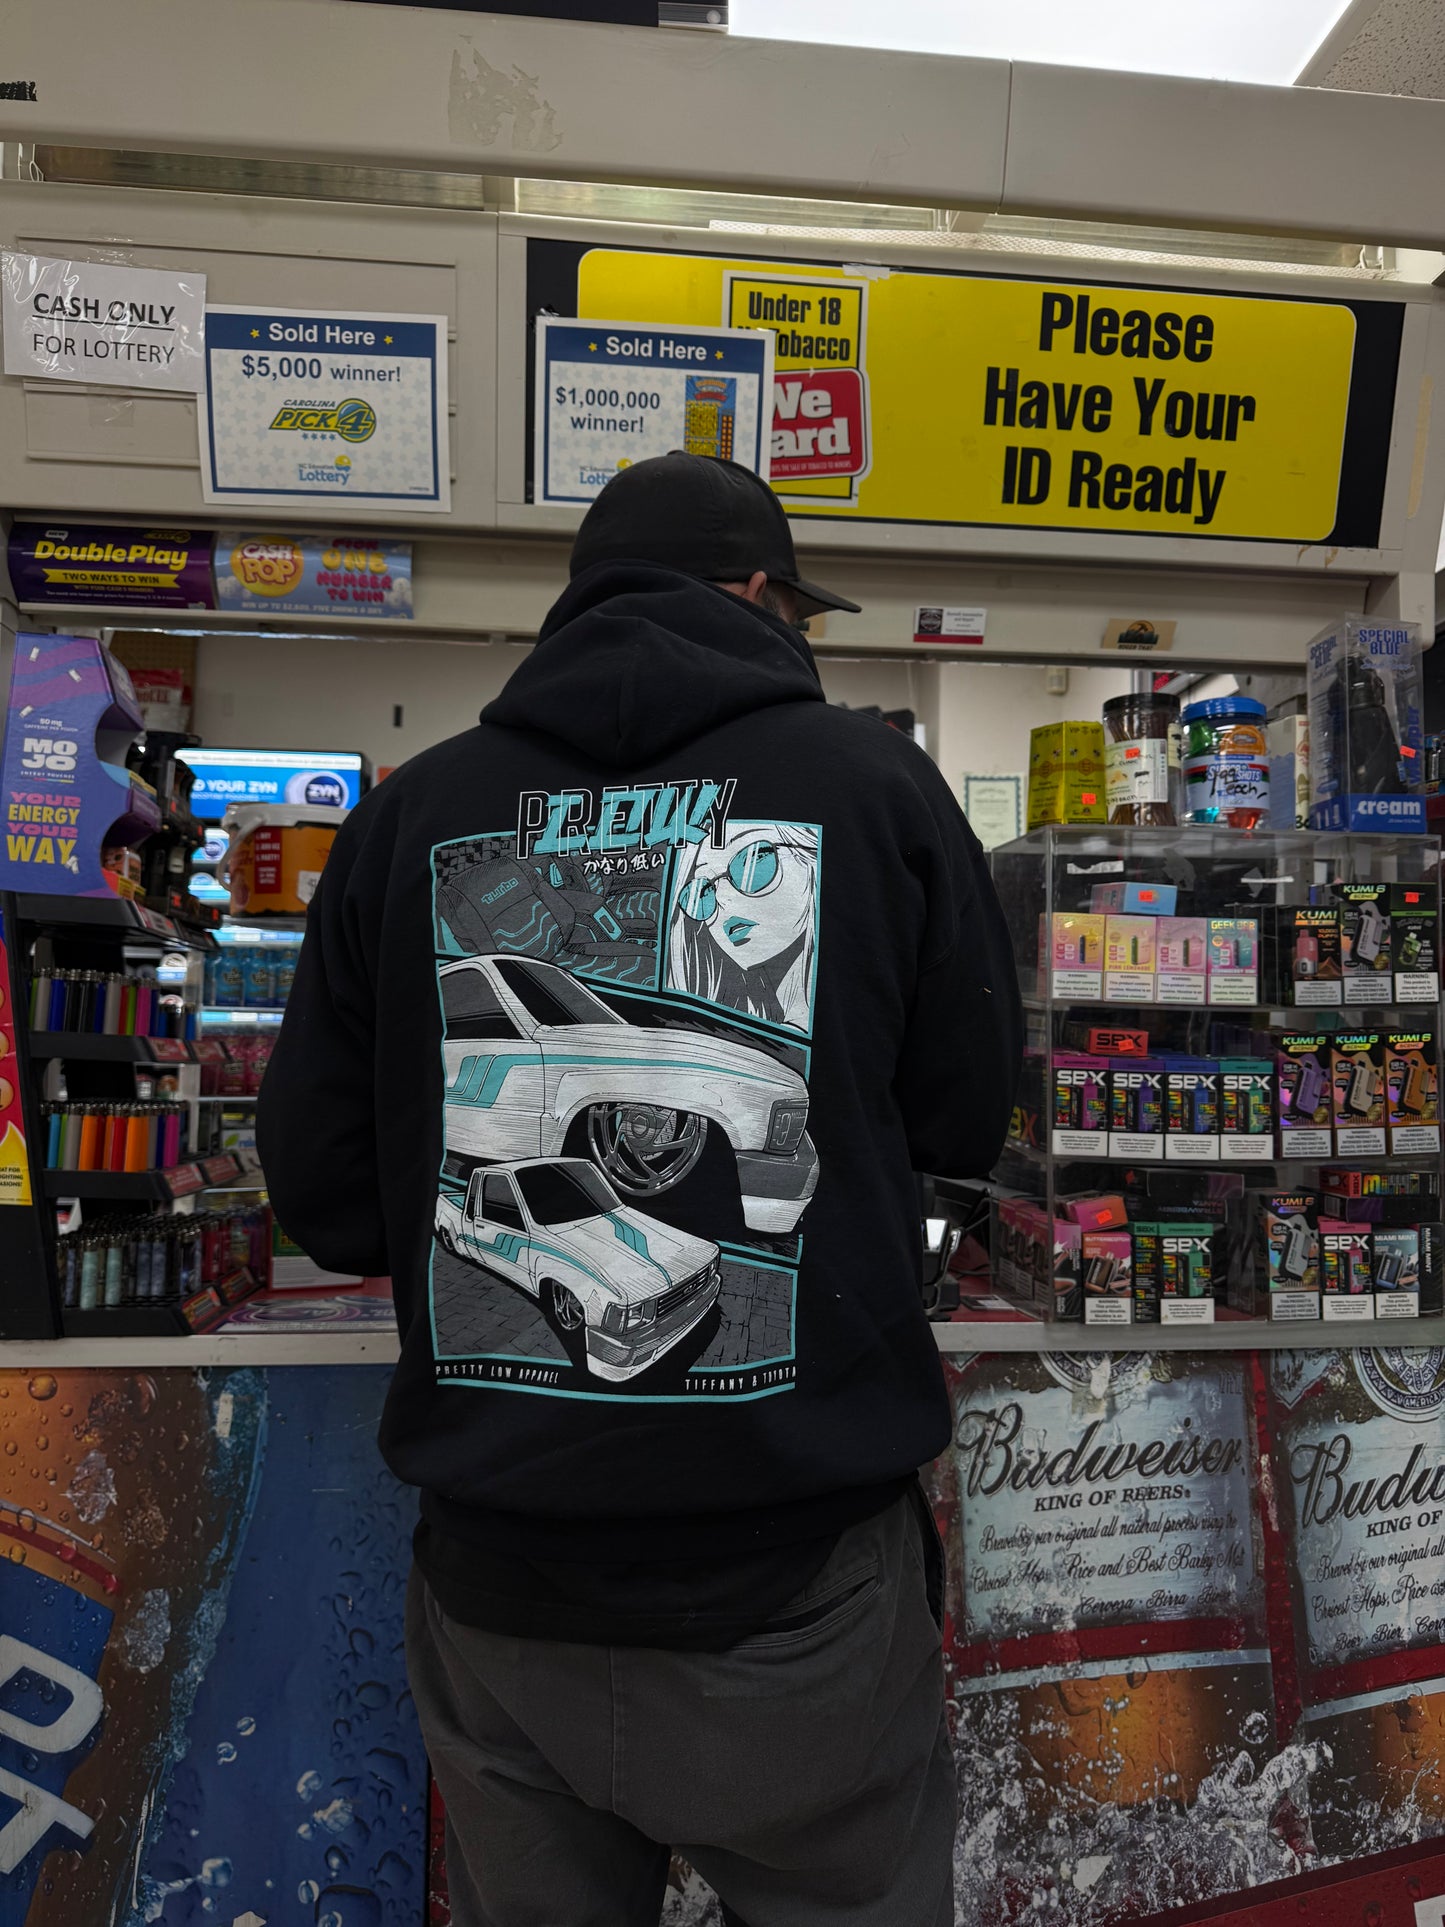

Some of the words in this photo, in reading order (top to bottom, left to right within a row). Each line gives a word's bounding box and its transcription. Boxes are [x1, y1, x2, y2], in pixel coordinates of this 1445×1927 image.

[33, 293, 99, 319] CASH
[108, 300, 175, 325] ONLY
[748, 291, 811, 324] Under
[818, 297, 842, 326] 18
[269, 322, 318, 343] Sold
[325, 326, 376, 345] Here
[1039, 291, 1214, 363] Please
[33, 334, 76, 356] FOR
[84, 339, 175, 364] LOTTERY
[605, 336, 653, 358] Sold
[659, 340, 708, 361] Here
[242, 355, 322, 380] $5,000
[330, 364, 401, 382] winner!
[283, 399, 336, 408] CAROLINA
[555, 386, 660, 410] $1,000,000
[983, 366, 1113, 433] Have
[1133, 376, 1256, 442] Your
[276, 412, 336, 428] PICK
[338, 409, 373, 434] 4
[570, 413, 644, 433] winner!
[771, 417, 851, 459] ard
[299, 469, 350, 485] Lottery
[580, 472, 612, 485] Lott
[1001, 446, 1052, 505] ID
[1068, 449, 1227, 525] Ready
[243, 544, 294, 560] CASH
[322, 551, 388, 573] ONE
[62, 573, 87, 581] TWO
[90, 574, 119, 583] WAYS
[122, 575, 135, 583] TO
[138, 575, 160, 584] WIN
[241, 558, 296, 585] POP
[316, 572, 392, 590] NUMBER
[326, 588, 348, 601] TO
[352, 589, 385, 603] WIN
[1359, 628, 1409, 644] SPECIAL
[1310, 635, 1337, 660] SPECIAL
[1370, 641, 1401, 655] BLUE
[1314, 649, 1332, 669] BLUE
[23, 737, 78, 756] MO
[22, 754, 77, 771] JO
[10, 791, 81, 807] YOUR
[307, 783, 340, 797] ZYN
[8, 804, 80, 825] ENERGY
[1357, 800, 1421, 816] cream
[516, 777, 738, 860] PRETTY
[7, 822, 78, 838] YOUR
[583, 853, 666, 876] かなり低い
[1343, 885, 1375, 893] KUMI
[1376, 884, 1386, 893] 6
[1211, 920, 1235, 930] GEEK
[1295, 910, 1337, 920] KUMI
[1282, 1037, 1315, 1045] KUMI
[1316, 1036, 1326, 1045] 6
[1335, 1035, 1367, 1044] KUMI
[1368, 1034, 1379, 1043] 6
[1388, 1034, 1420, 1043] KUMI
[1421, 1033, 1432, 1042] 6
[1272, 1197, 1303, 1206] KUMI
[435, 1365, 484, 1376] PRETTY
[490, 1365, 512, 1379] LOW
[517, 1368, 559, 1385] APPAREL
[685, 1377, 744, 1391] TIFFANY
[752, 1376, 758, 1387] &
[763, 1366, 797, 1385] TOYOTA
[1405, 1393, 1440, 1407] AMERICA
[956, 1401, 1243, 1498] Budweiser
[1033, 1491, 1083, 1513] KING
[1087, 1490, 1116, 1508] OF
[1122, 1485, 1184, 1504] BEERS
[1054, 1517, 1100, 1551] original
[1100, 1516, 1118, 1538] all
[1119, 1512, 1160, 1537] natural
[1158, 1513, 1199, 1543] process
[1366, 1517, 1411, 1538] KING
[1418, 1511, 1443, 1529] OF
[1064, 1552, 1096, 1579] Rice
[1097, 1553, 1125, 1578] and
[1126, 1544, 1166, 1575] Best
[1168, 1543, 1213, 1575] Barley
[1369, 1556, 1386, 1570] our
[1387, 1538, 1430, 1572] original
[1431, 1535, 1445, 1556] all
[1079, 1595, 1136, 1616] Cerveza
[1146, 1588, 1187, 1610] Birra
[1312, 1595, 1350, 1622] Choicest
[1351, 1582, 1390, 1618] Hops,
[1391, 1573, 1428, 1605] Rice
[1372, 1624, 1403, 1643] Bier
